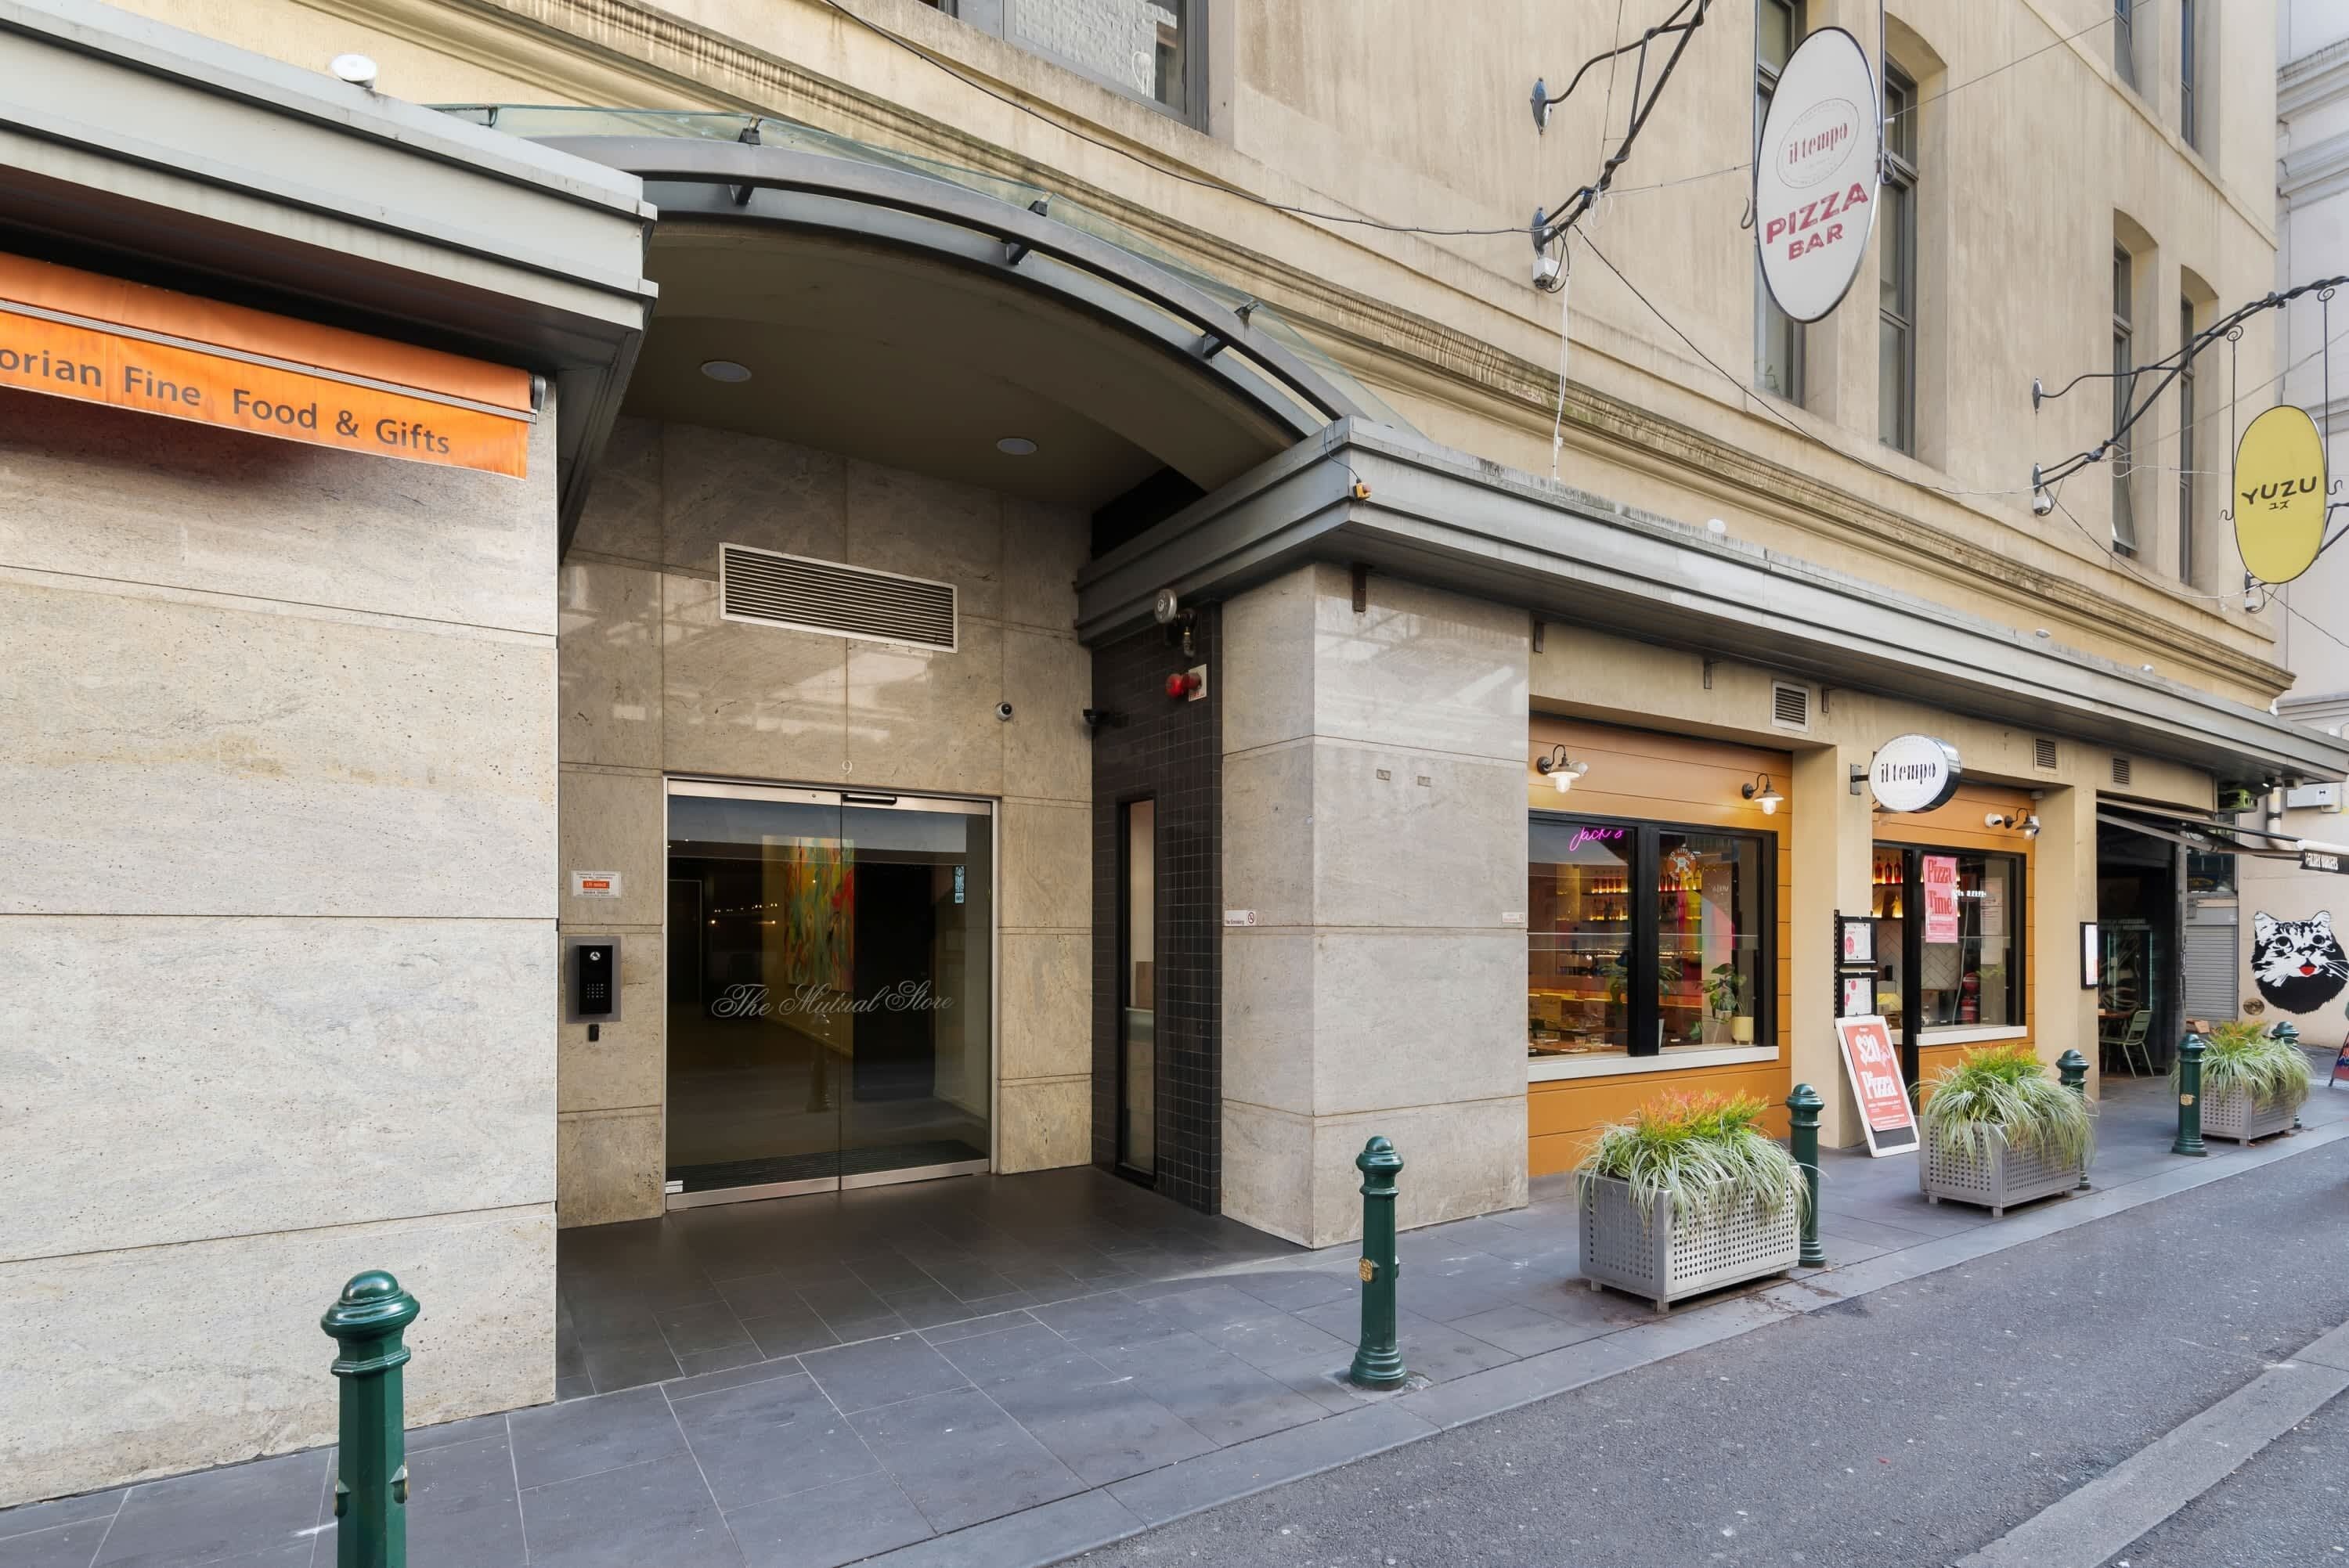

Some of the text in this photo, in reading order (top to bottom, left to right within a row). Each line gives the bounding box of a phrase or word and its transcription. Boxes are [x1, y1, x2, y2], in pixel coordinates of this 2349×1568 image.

[1789, 122, 1848, 164] il tempo
[1766, 182, 1868, 244] PIZZA
[1788, 223, 1844, 261] BAR
[124, 366, 201, 406] Fine
[233, 388, 317, 429] Food
[335, 410, 359, 437] &
[375, 420, 450, 455] Gifts
[2241, 476, 2317, 505] YUZU
[1882, 762, 1936, 784] il tempo
[1928, 859, 1952, 884] Pizza
[1929, 890, 1952, 914] Time
[711, 980, 954, 1018] The Mutual Store
[1860, 1070, 1898, 1099] Pizza
